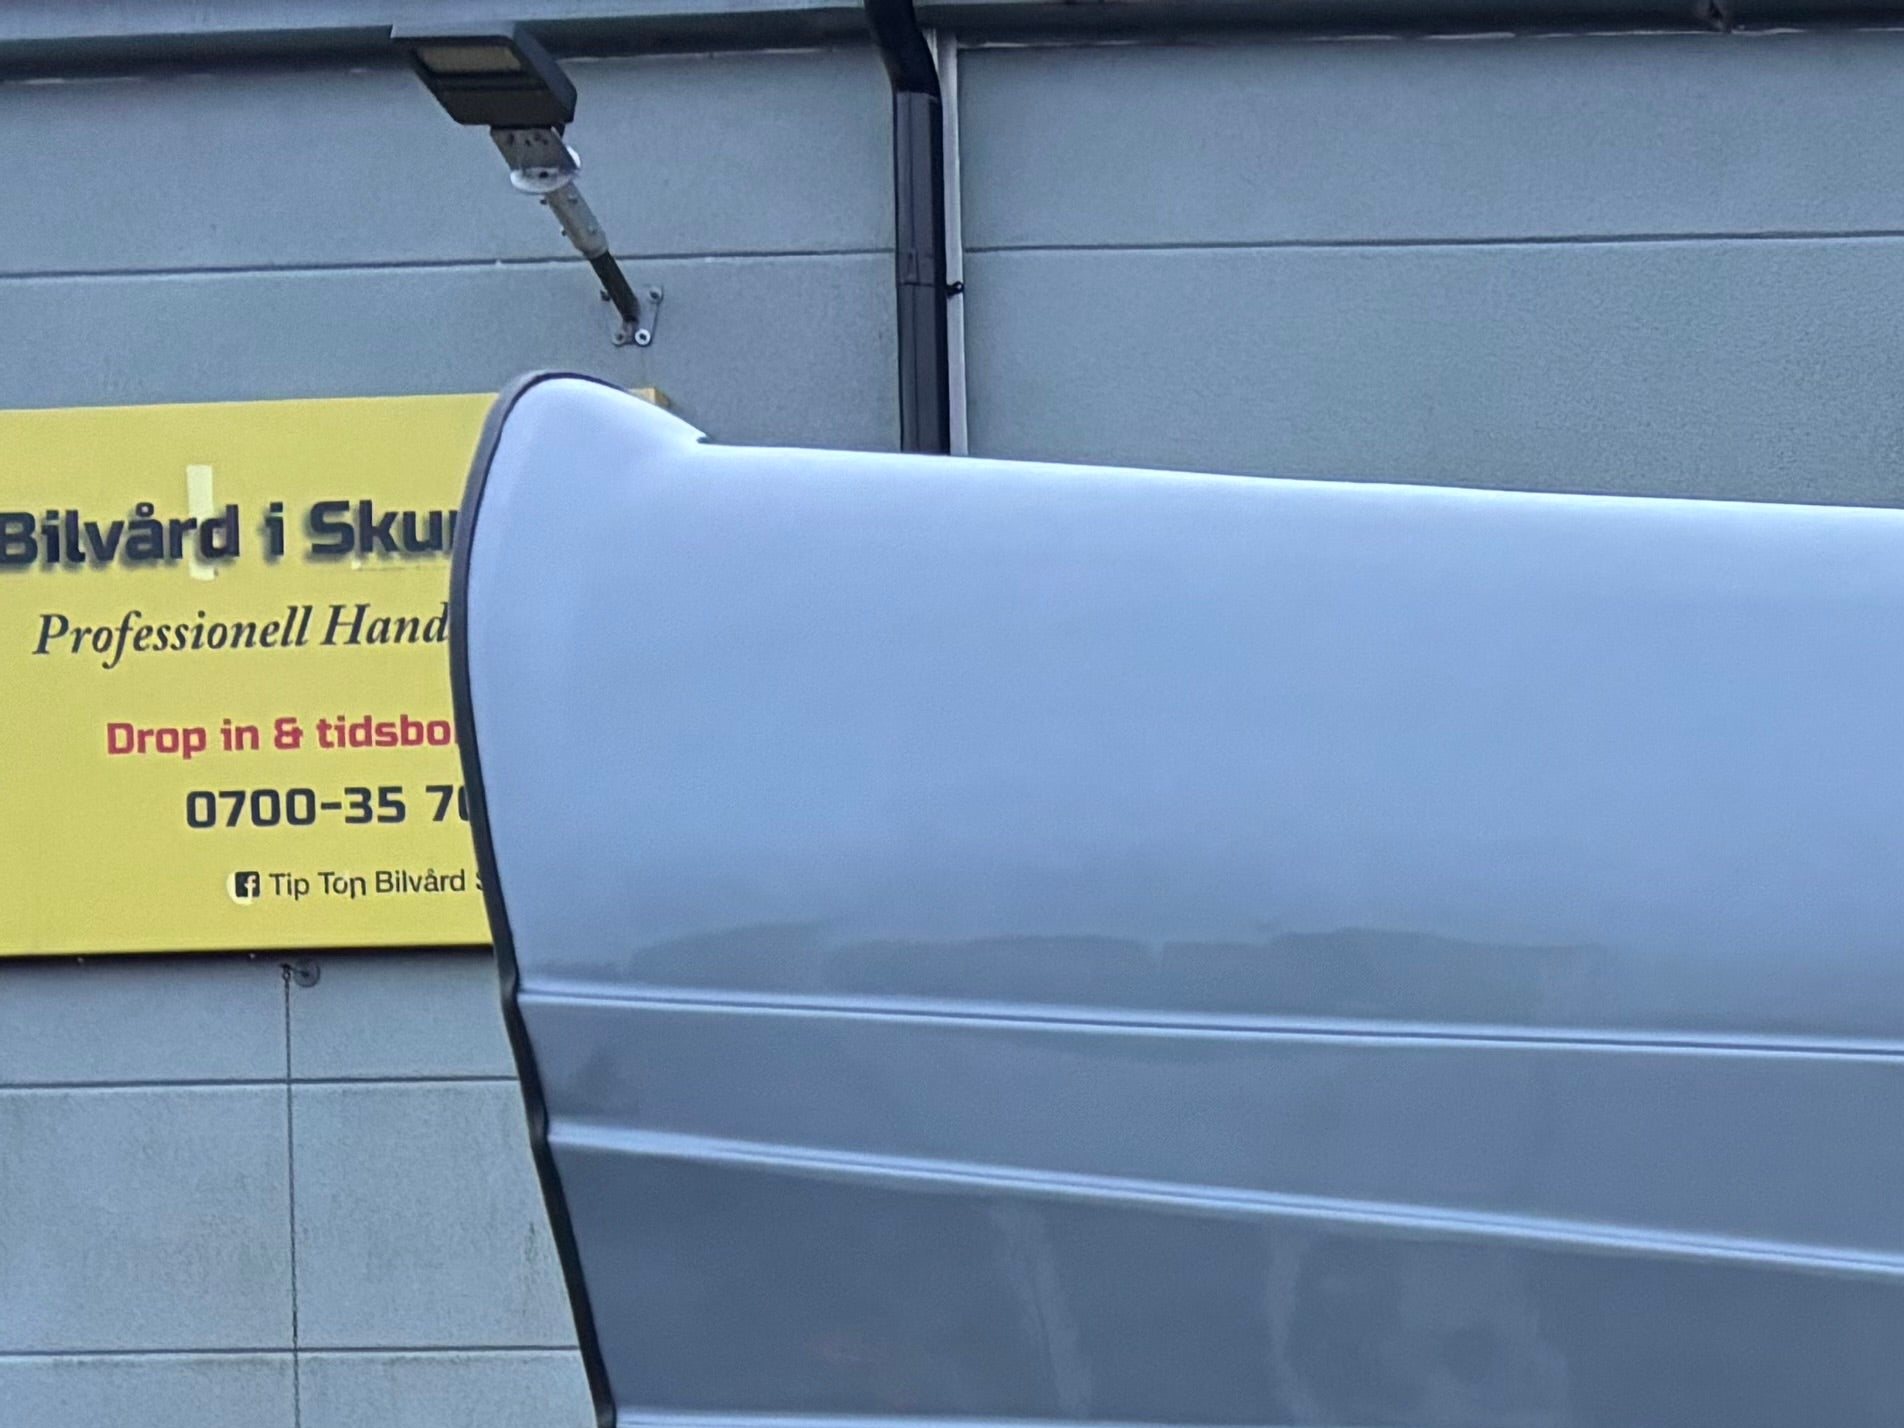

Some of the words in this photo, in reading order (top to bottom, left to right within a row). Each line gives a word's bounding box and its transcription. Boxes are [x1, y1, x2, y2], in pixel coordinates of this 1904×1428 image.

[0, 502, 239, 565] Bilvård
[266, 502, 285, 559] i
[32, 605, 312, 669] Professionell
[320, 602, 449, 648] Hand
[106, 722, 206, 760] Drop
[221, 718, 259, 752] in
[273, 718, 303, 751] &
[318, 714, 457, 749] tidsbo
[186, 785, 407, 829] 0700-35
[269, 872, 310, 900] Tip
[375, 867, 465, 896] Bilvård
